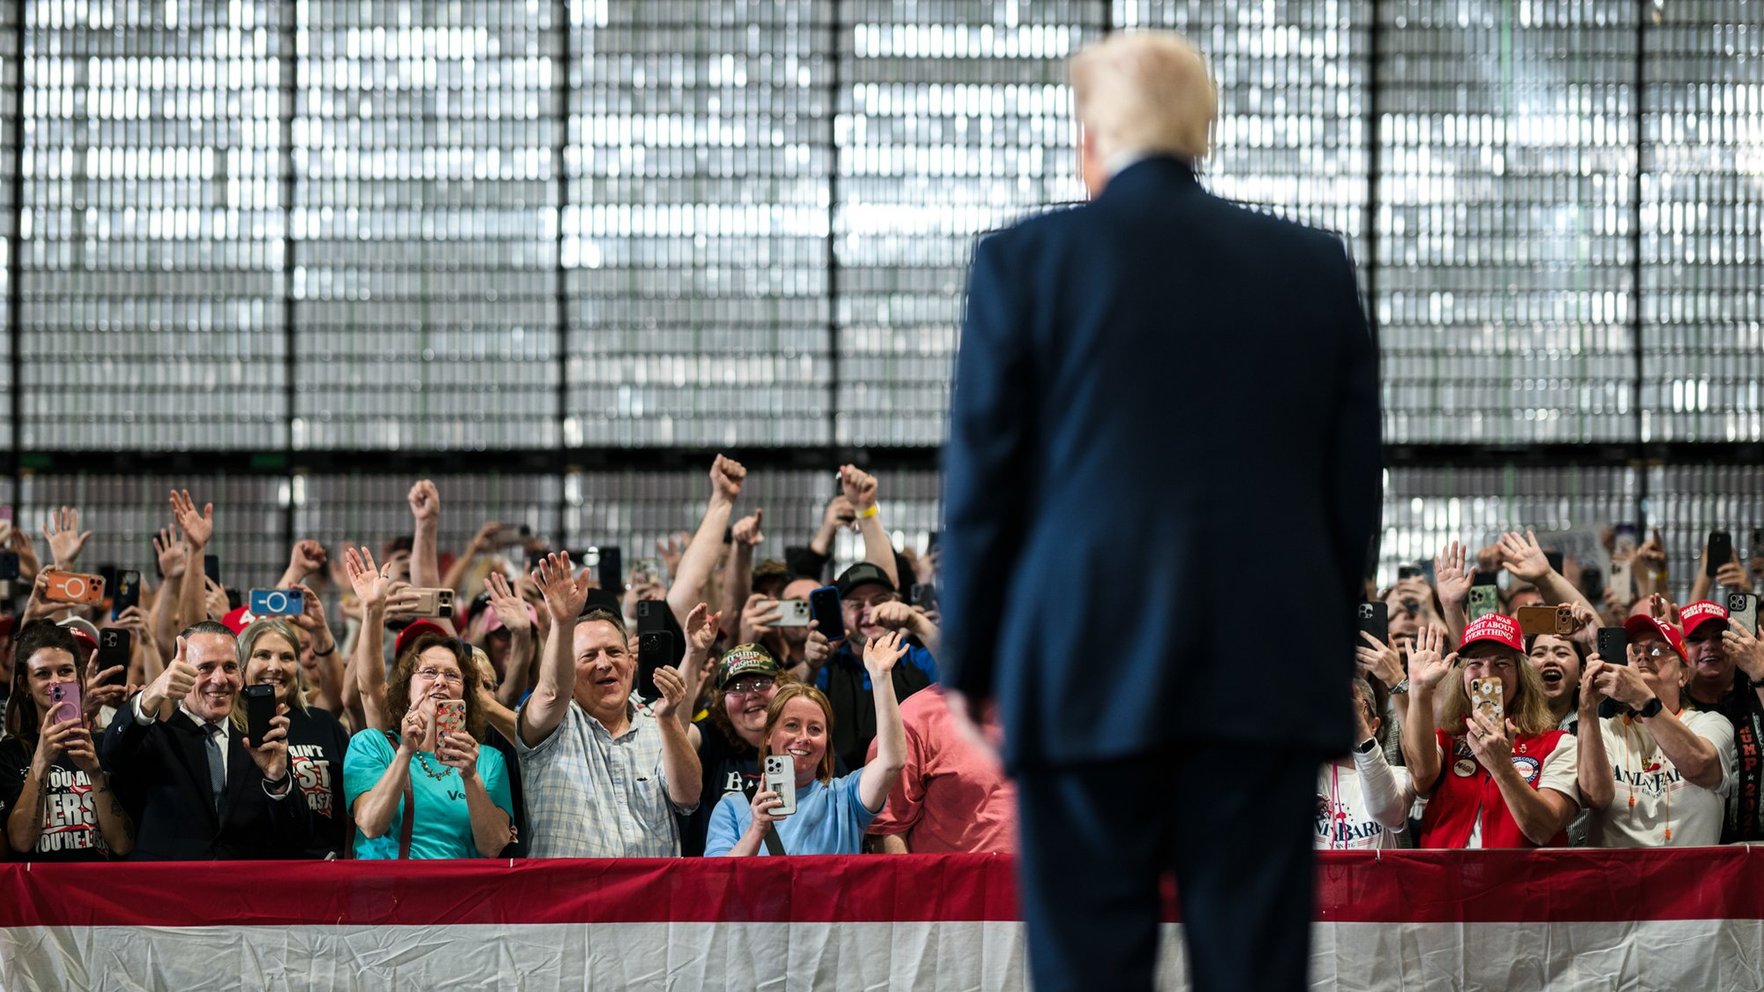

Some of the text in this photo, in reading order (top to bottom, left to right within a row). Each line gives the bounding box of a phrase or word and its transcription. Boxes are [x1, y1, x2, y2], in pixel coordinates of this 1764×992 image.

[1496, 615, 1511, 625] WAS
[1487, 621, 1515, 633] ABOUT
[1465, 628, 1513, 643] EVERYTHING!
[42, 791, 98, 828] ERS
